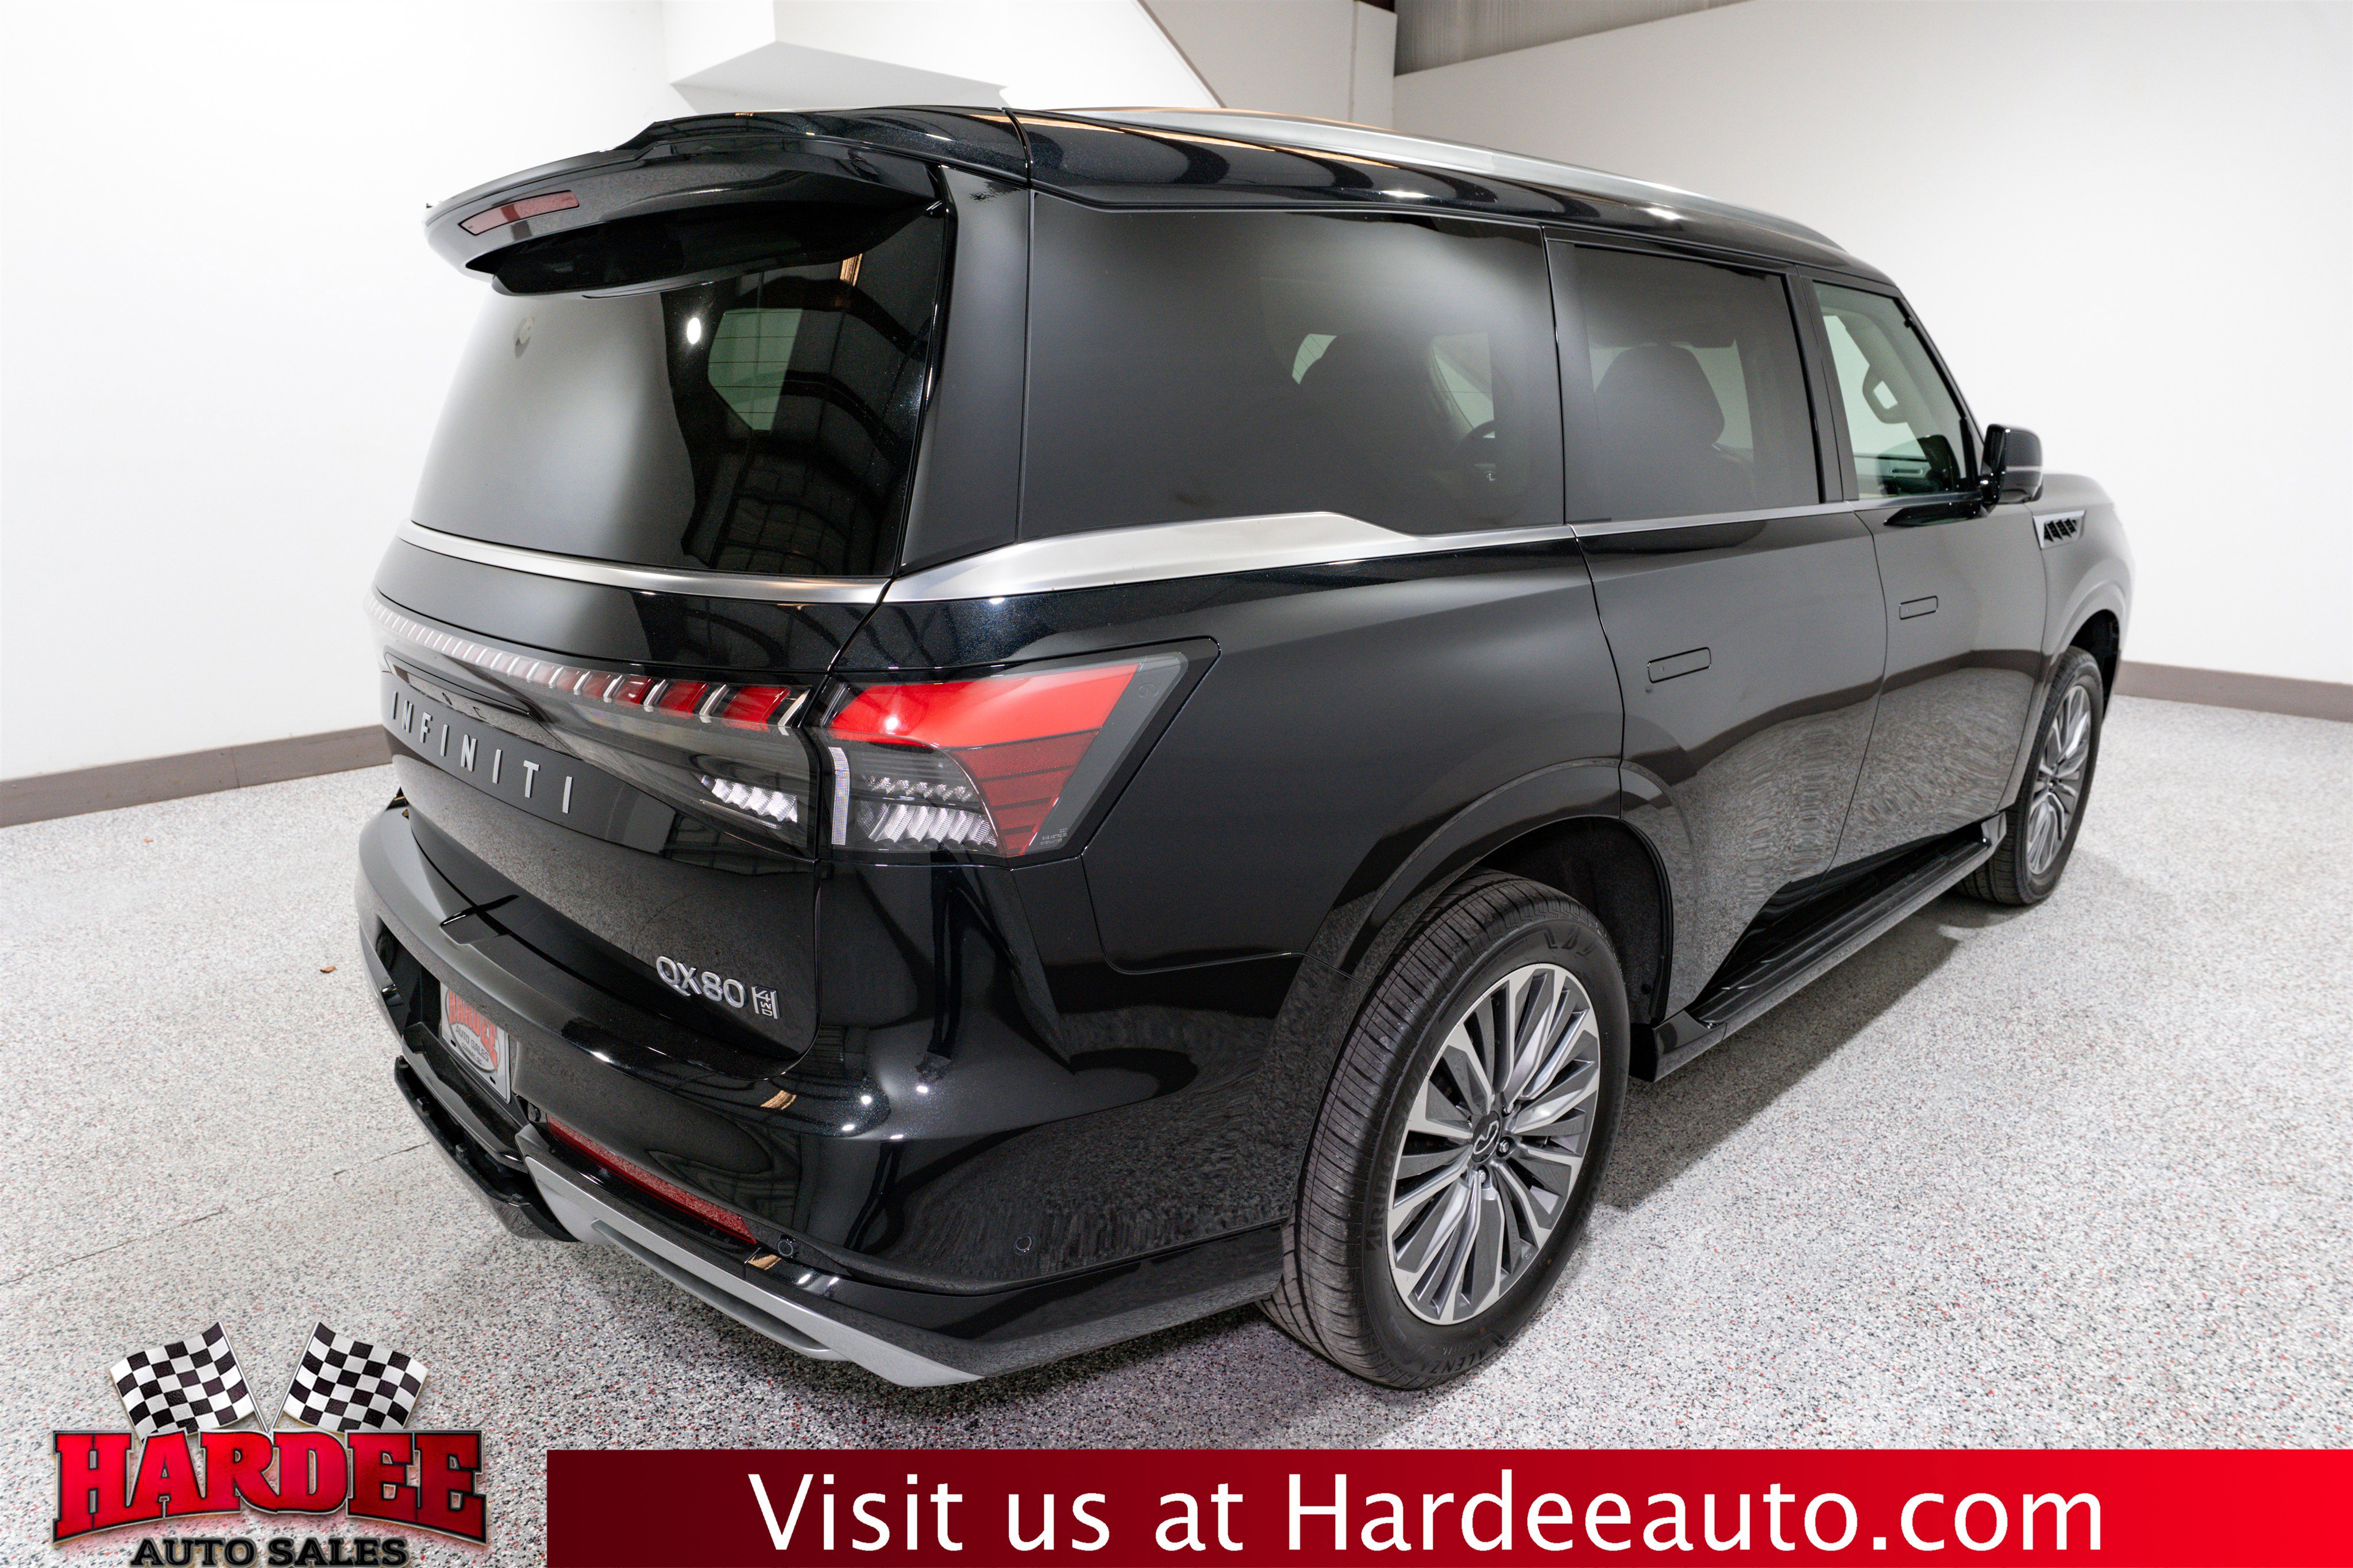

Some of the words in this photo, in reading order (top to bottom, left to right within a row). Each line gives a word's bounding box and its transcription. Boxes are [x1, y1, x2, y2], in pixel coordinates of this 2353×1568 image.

[391, 690, 573, 814] INFINITI
[656, 956, 746, 1009] QX80
[456, 1025, 470, 1044] AUTO
[471, 1039, 489, 1062] SALES
[1365, 1036, 1437, 1252] BRIDGESTONE
[1421, 1346, 1488, 1374] ALENZA
